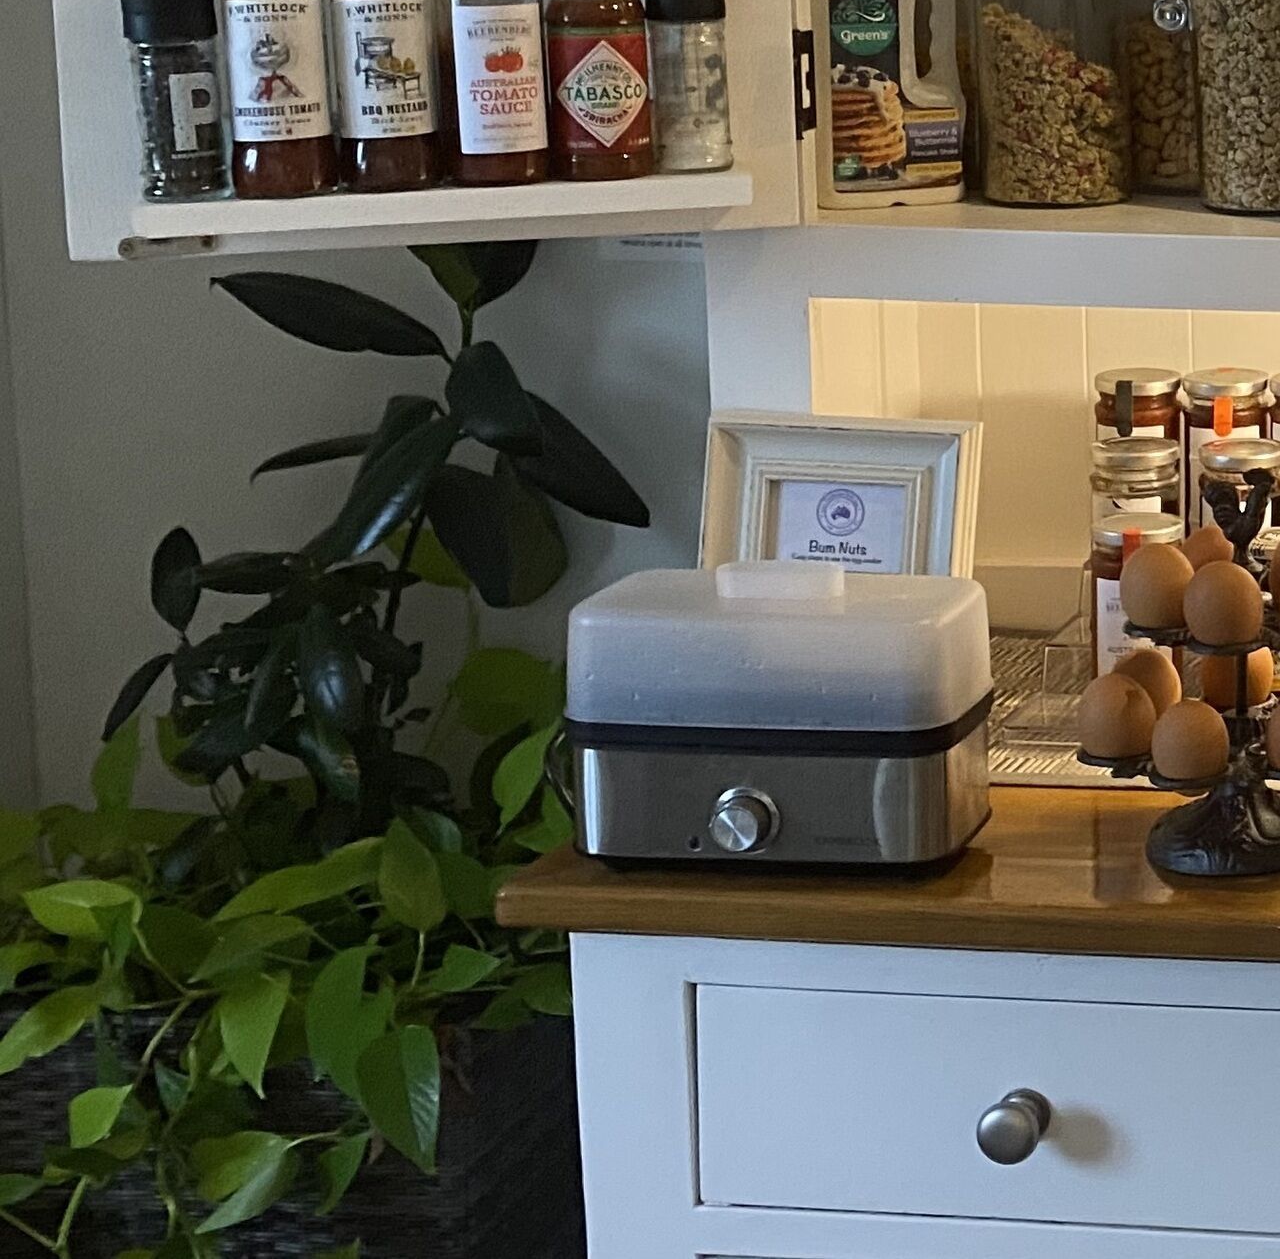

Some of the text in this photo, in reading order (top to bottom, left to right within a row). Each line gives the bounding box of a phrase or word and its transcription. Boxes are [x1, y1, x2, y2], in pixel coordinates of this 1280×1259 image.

[841, 30, 888, 44] Green's
[471, 77, 537, 87] AUSTRALIAN
[470, 87, 538, 101] TOMATO
[565, 84, 641, 101] TABASCO
[289, 103, 320, 115] TOMATO
[362, 101, 428, 116] BBQ MUSTARD
[480, 101, 532, 115] SAUCE
[582, 110, 628, 125] SRIRACHA
[809, 540, 867, 555] Bum Nuts
